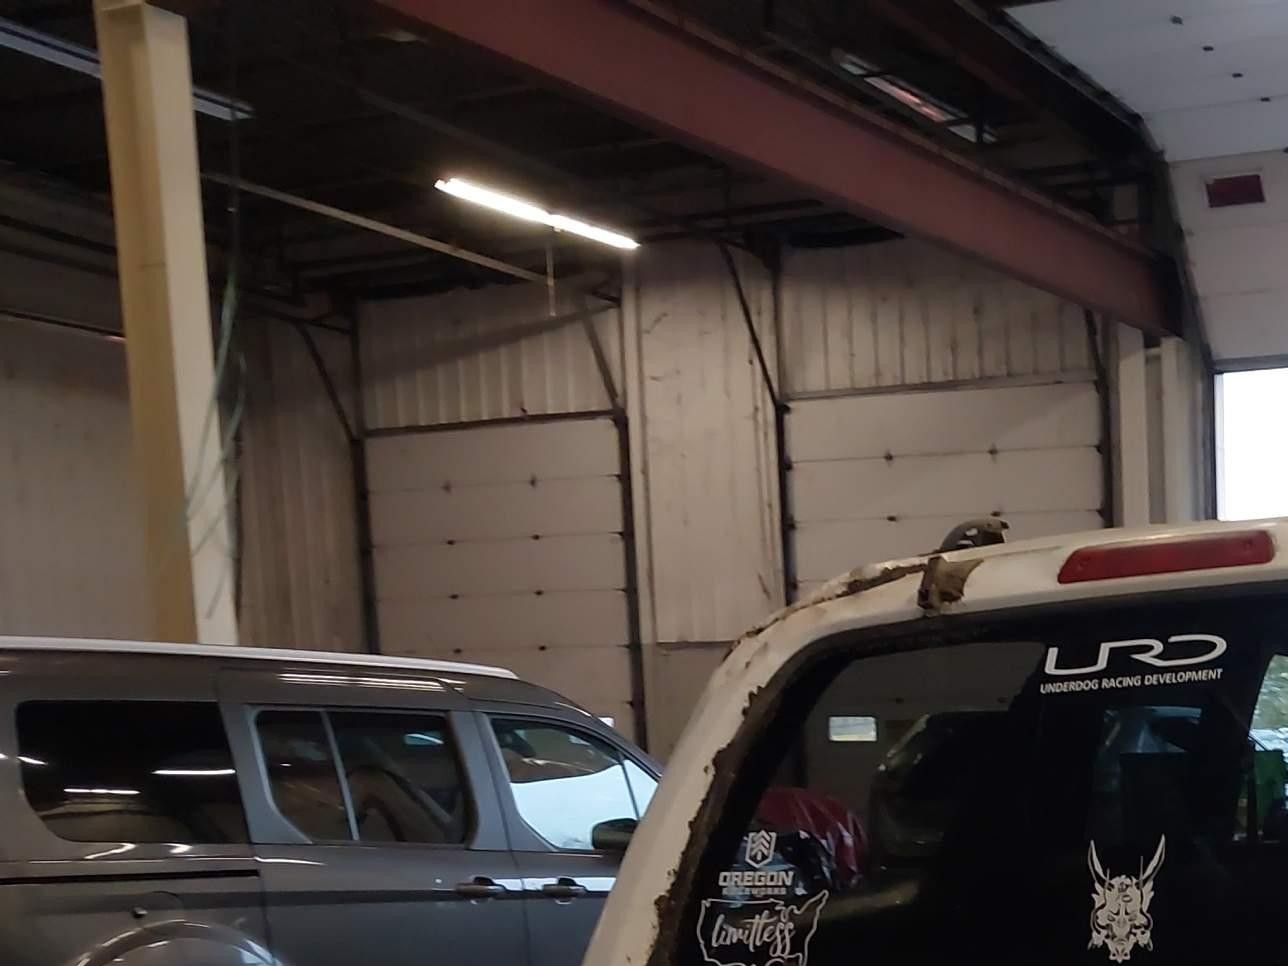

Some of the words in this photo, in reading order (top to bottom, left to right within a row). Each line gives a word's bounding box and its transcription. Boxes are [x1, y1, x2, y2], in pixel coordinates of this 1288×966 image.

[1040, 679, 1099, 694] UNDERDOG
[1101, 675, 1141, 690] RACING
[1144, 668, 1224, 686] DEVELOPMENT
[718, 871, 795, 887] OREGON
